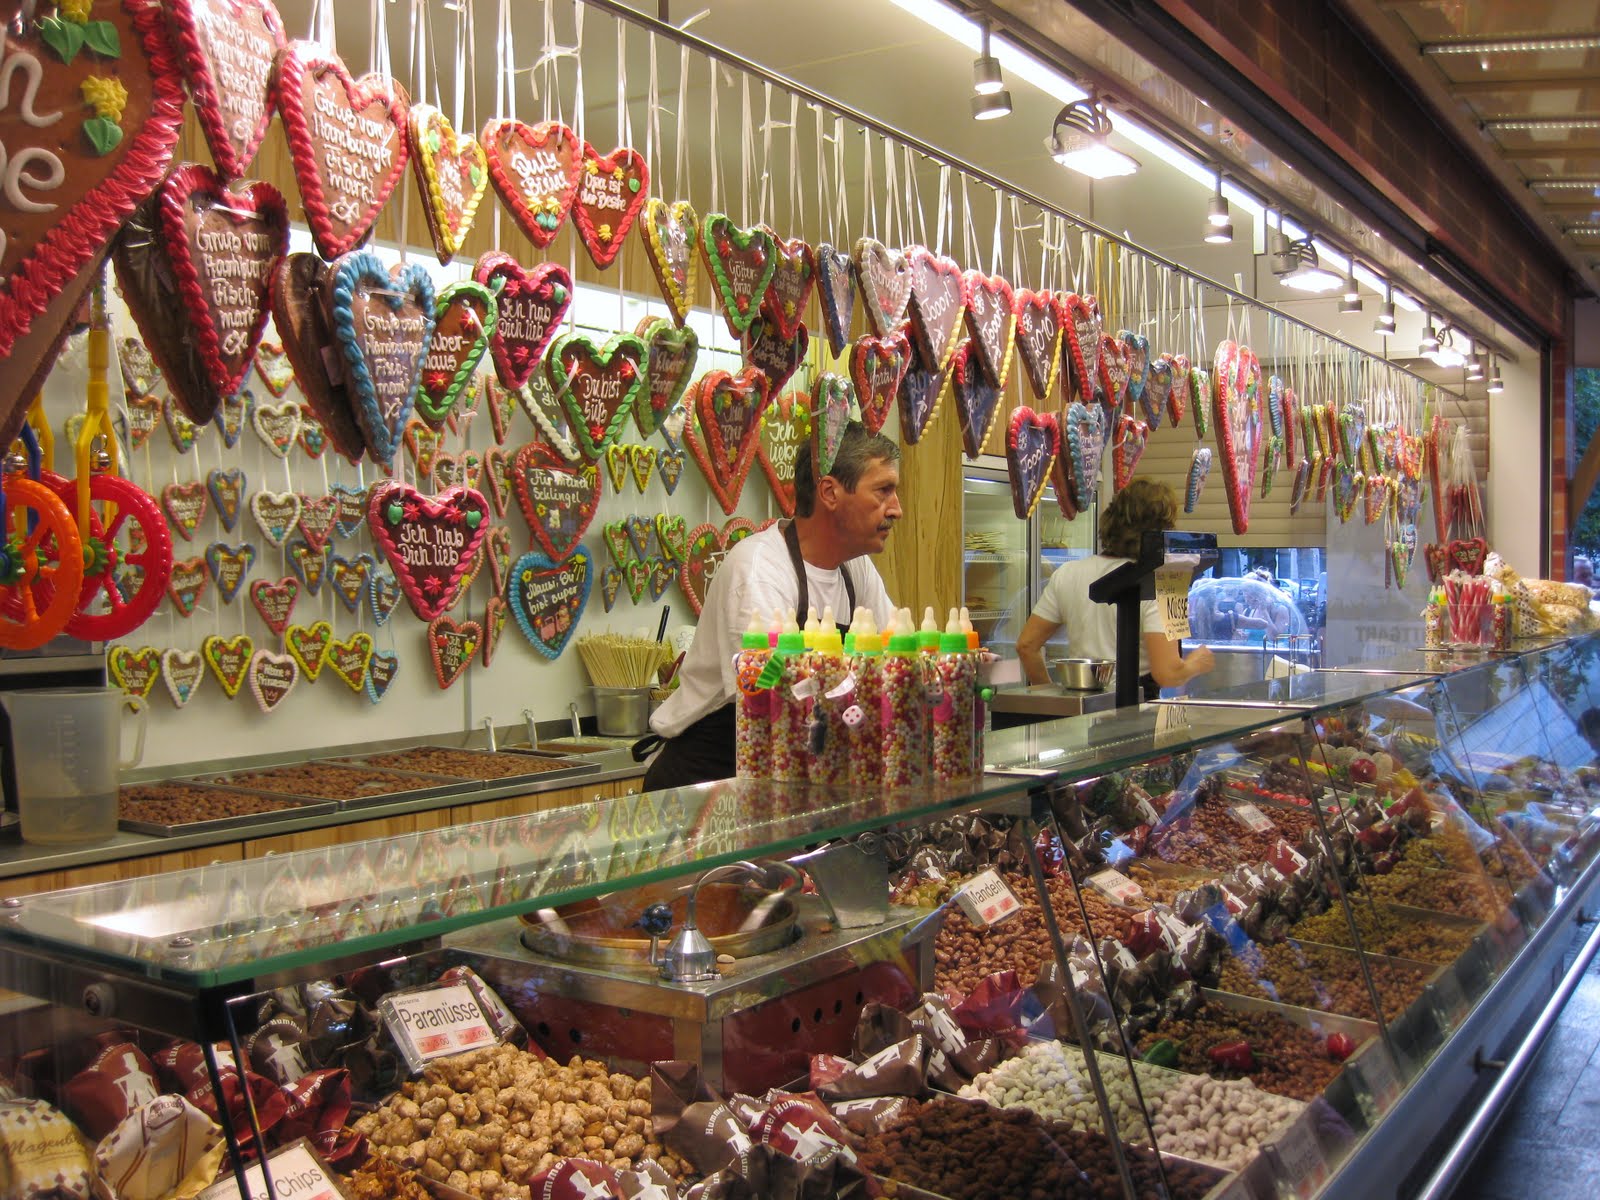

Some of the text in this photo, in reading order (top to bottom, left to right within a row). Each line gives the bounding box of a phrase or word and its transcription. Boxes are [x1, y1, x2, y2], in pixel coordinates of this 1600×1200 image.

[357, 115, 386, 139] vom
[313, 112, 392, 173] Hamburger
[585, 171, 625, 194] Opa ist
[597, 191, 627, 212] Beste
[196, 224, 271, 253] Gruß vom
[502, 297, 552, 323] Ich hab
[498, 318, 544, 341] Dich lieb
[1031, 315, 1054, 358] 2010
[578, 373, 600, 399] Du
[600, 371, 622, 399] bist
[584, 399, 608, 426] süß
[767, 420, 799, 442] Ich
[530, 468, 553, 486] Für
[774, 460, 796, 481] Dic
[533, 486, 582, 509] Schlingel
[400, 523, 464, 548] Ich hab
[397, 543, 459, 567] Dich lieb
[559, 570, 577, 586] Du
[528, 585, 578, 615] bist super
[263, 663, 285, 678] Meine
[965, 877, 1006, 907] Mandeln
[398, 1000, 480, 1033] Paranüsse
[705, 1104, 726, 1135] Hummel
[774, 1099, 813, 1115] Hummel
[274, 1166, 323, 1198] Chips
[543, 1159, 567, 1200] ummel
